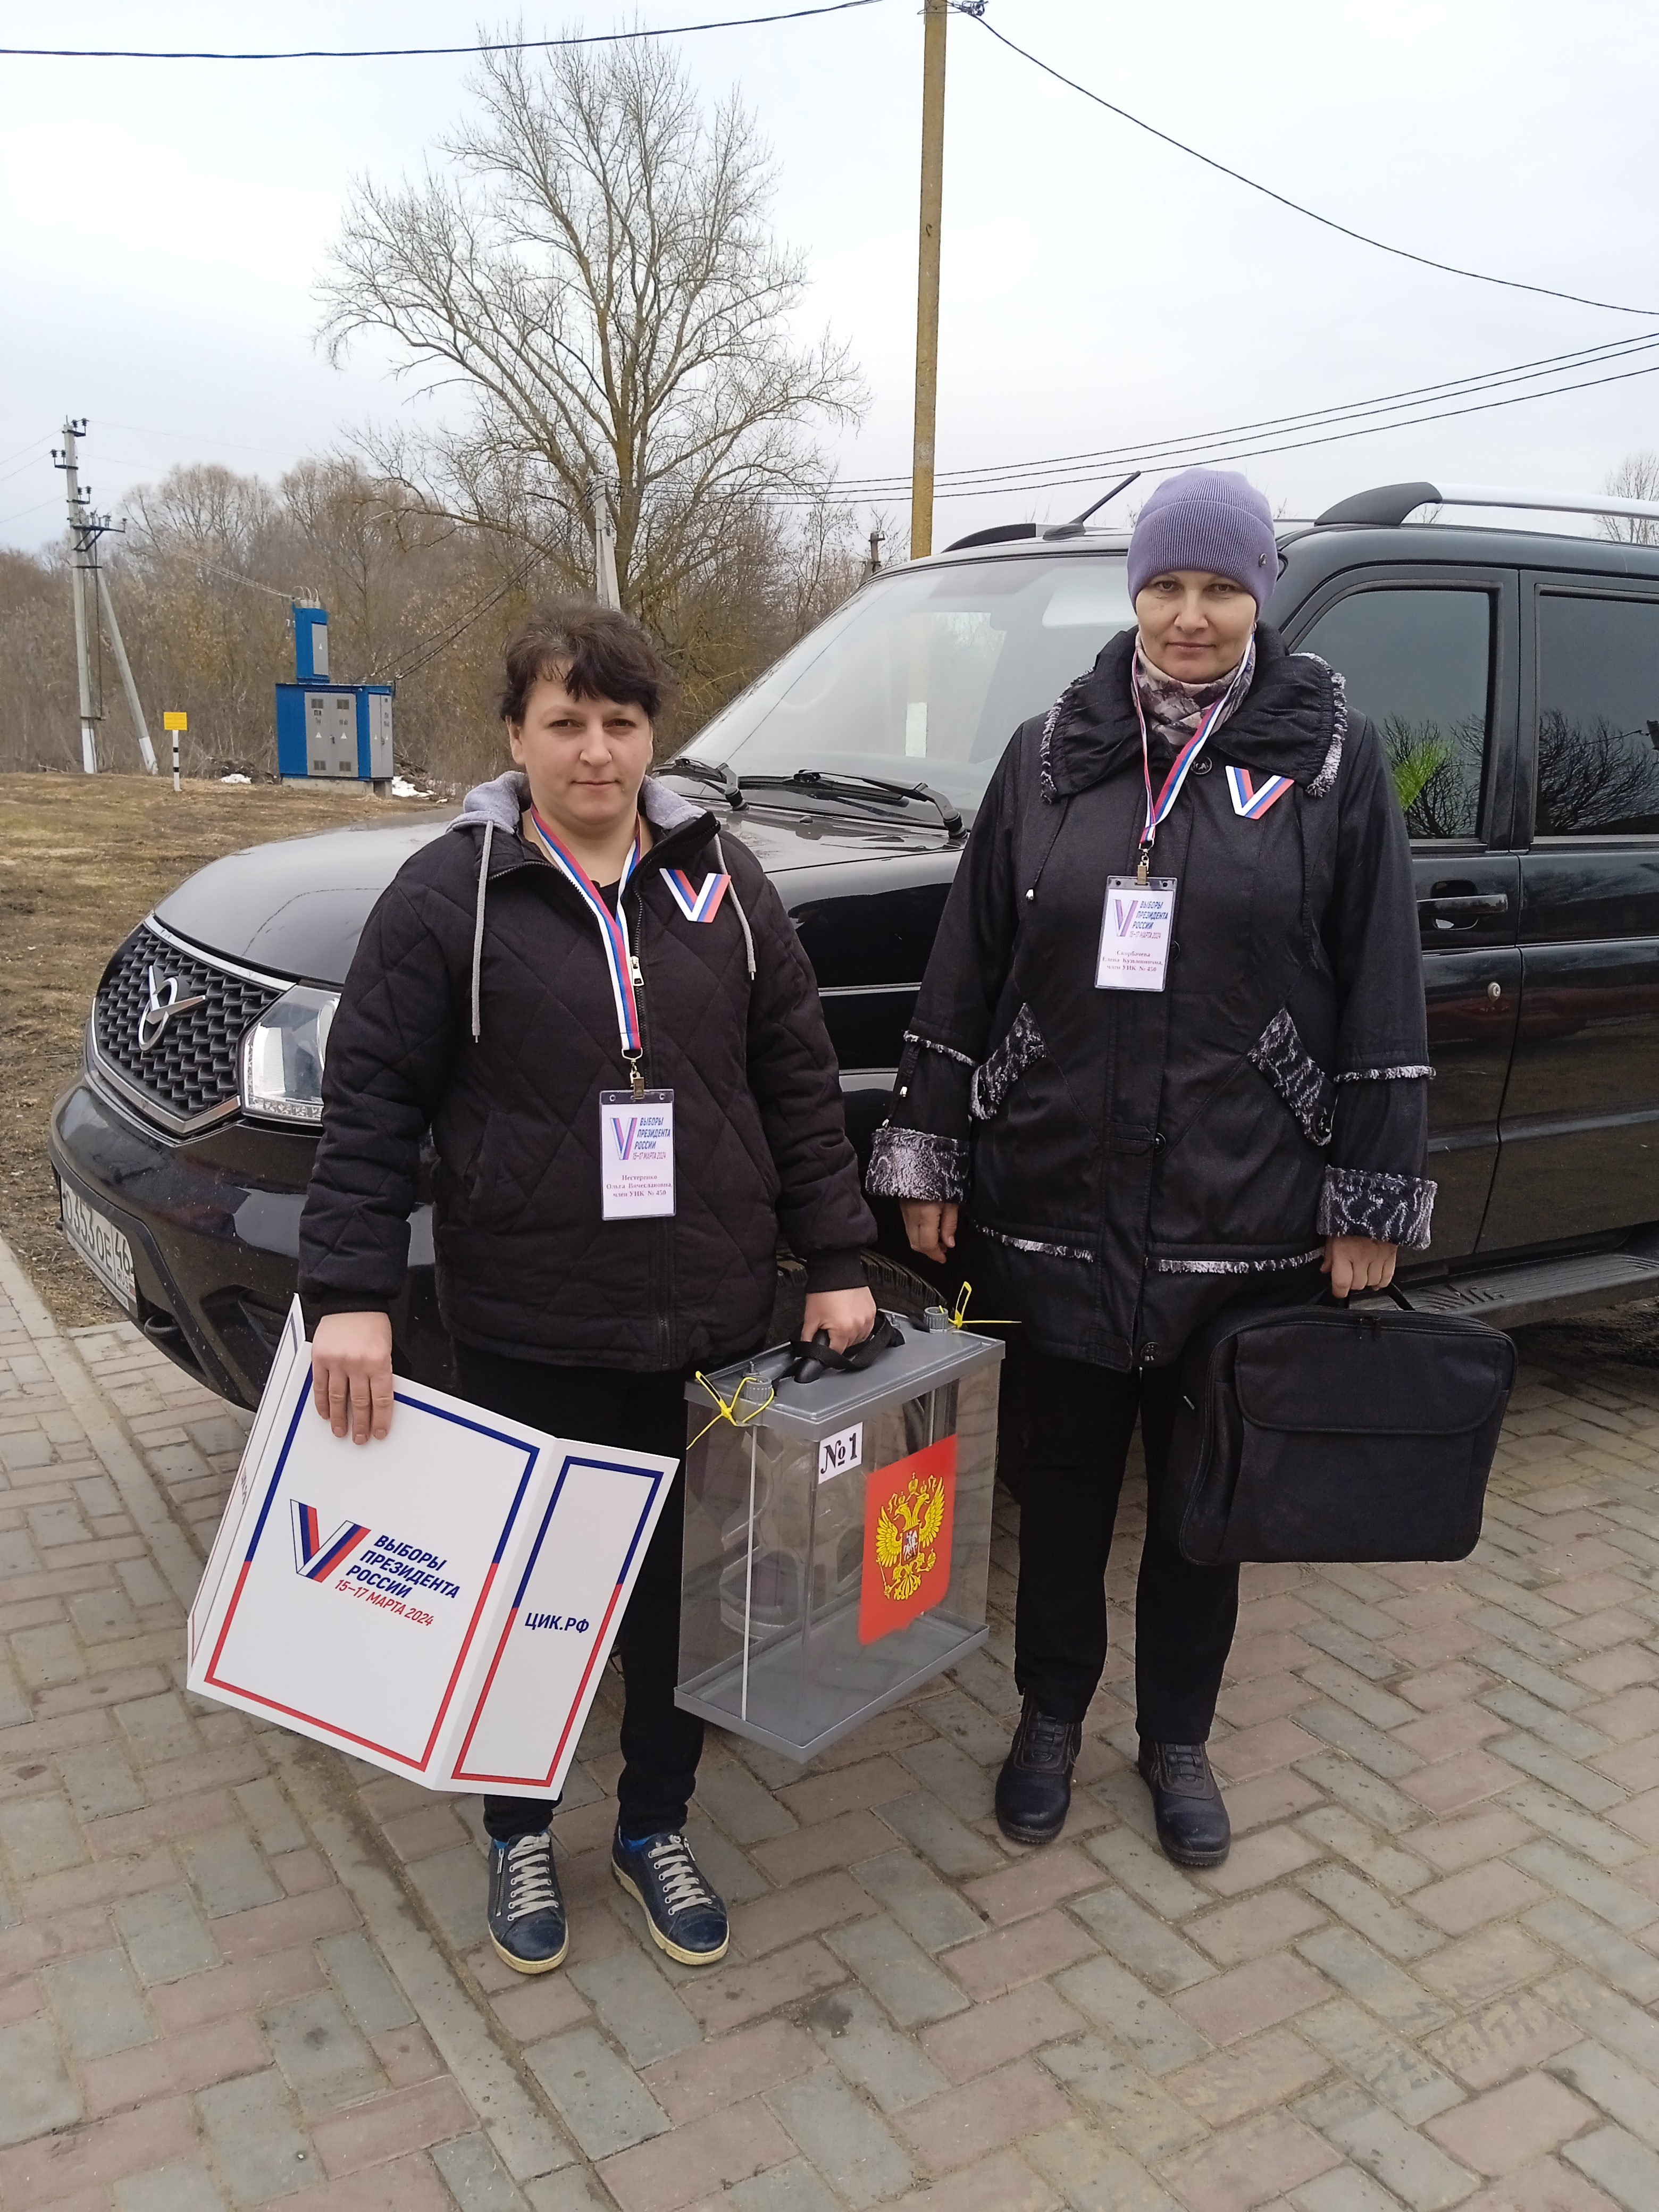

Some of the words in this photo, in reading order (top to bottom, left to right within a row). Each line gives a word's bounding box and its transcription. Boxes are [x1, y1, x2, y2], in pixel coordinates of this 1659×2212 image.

[1136, 911, 1169, 920] ПРЕЗИДЕНТА
[640, 1117, 664, 1126] ВЫБОРЫ
[637, 1129, 671, 1138] ПРЕЗИДЕНТА
[634, 1141, 656, 1150] РОССИИ
[374, 1535, 447, 1571] ВЫБОРЫ
[346, 1565, 413, 1598] РОССИИ
[359, 1549, 460, 1598] ПРЕЗИДЕНТА
[365, 1591, 406, 1615] МАРТА
[404, 1608, 434, 1626] 2024
[525, 1612, 589, 1632] ЦИК.РФ
